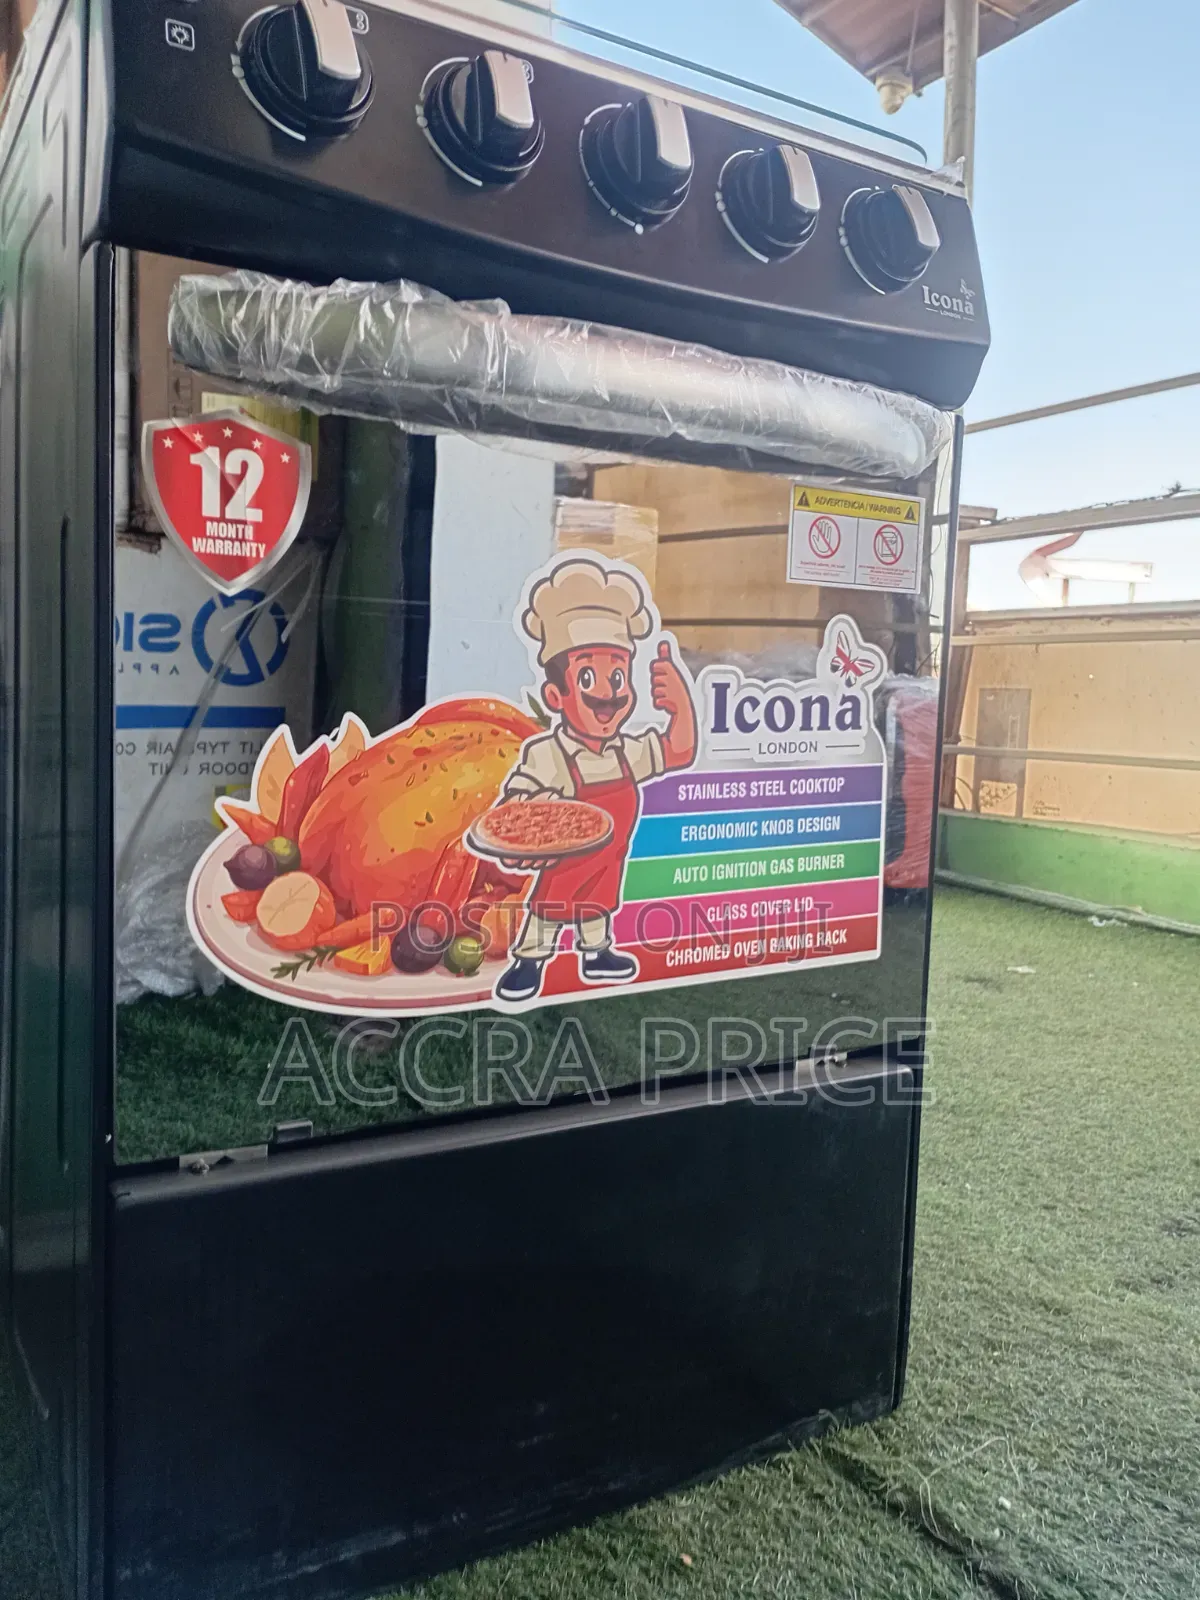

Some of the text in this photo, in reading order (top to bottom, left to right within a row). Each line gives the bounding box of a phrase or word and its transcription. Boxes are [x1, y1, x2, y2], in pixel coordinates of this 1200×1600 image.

[922, 286, 975, 315] Icona
[190, 446, 264, 522] 12
[815, 496, 864, 510] ADVERTENCIA
[869, 504, 901, 515] WARNING
[206, 521, 254, 541] MONTH
[192, 537, 267, 559] WARRANTY
[710, 682, 862, 734] Icona
[757, 740, 819, 755] LONDON
[678, 777, 845, 802] STAINLESS STEEL COOKTOP
[680, 815, 841, 843] ERGONOMIC KNOB DESIGN
[673, 853, 845, 885] AUTO IGNITION GAS BURNER
[706, 896, 813, 923] GLASS COVER LID
[666, 928, 848, 967] CHROMED OVEN BAKING RACK
